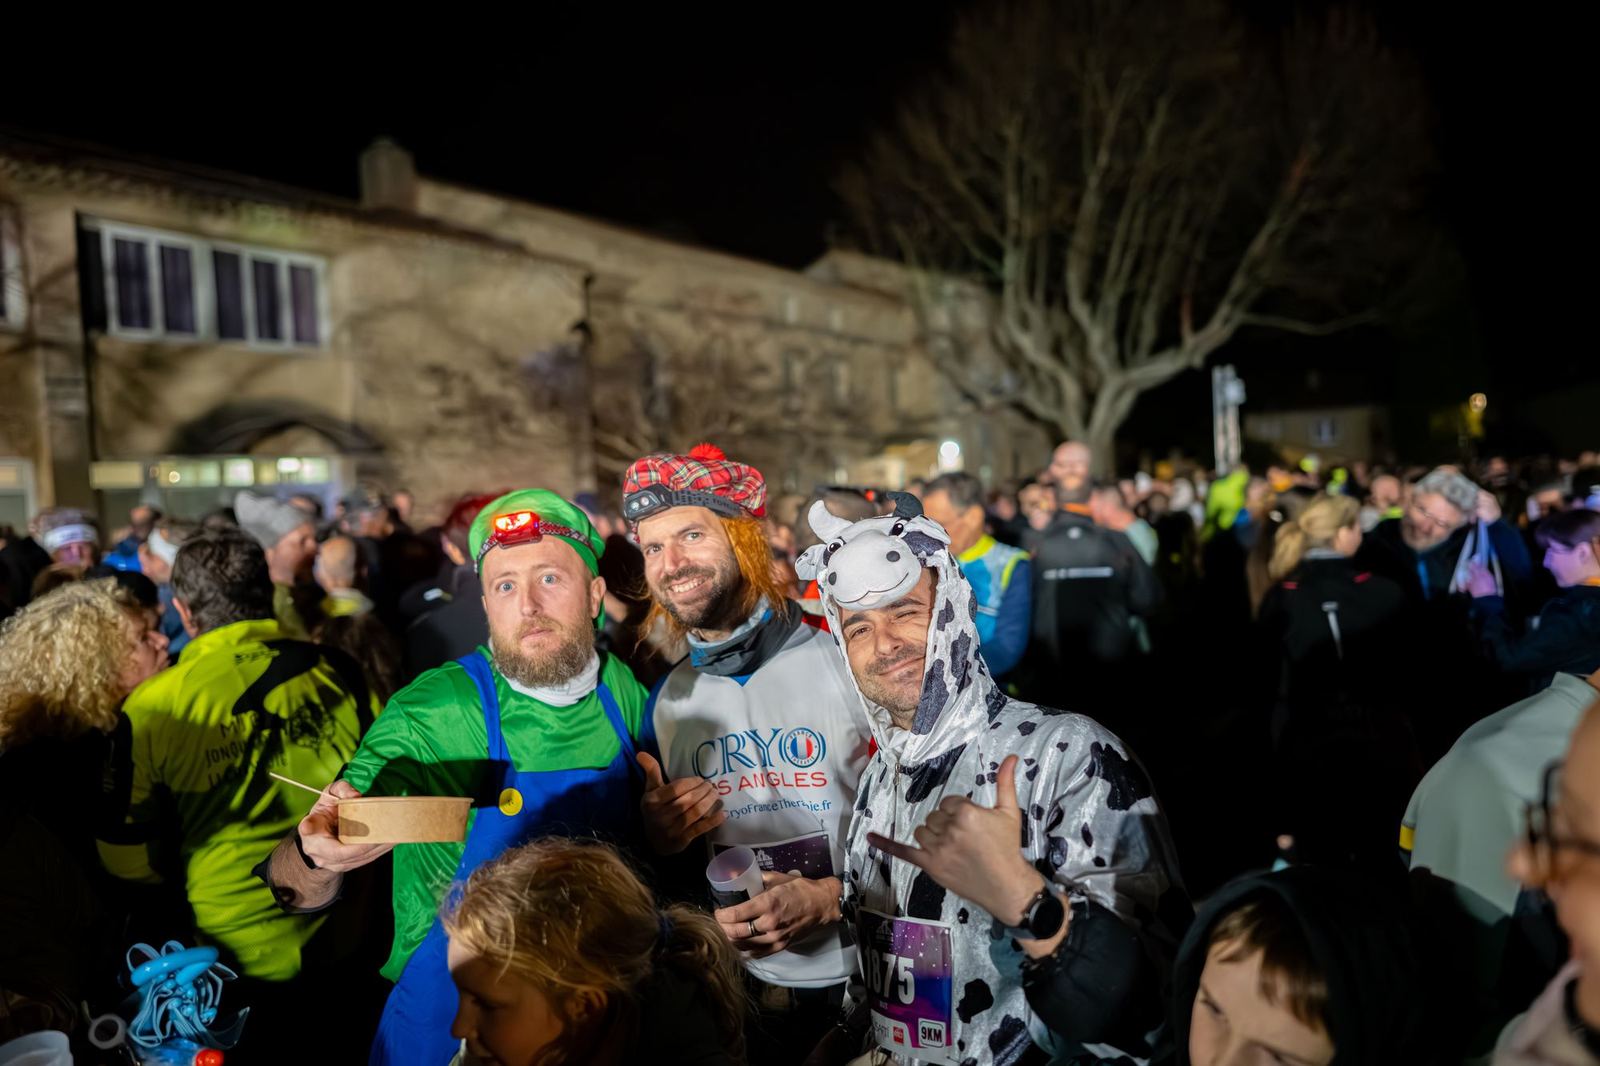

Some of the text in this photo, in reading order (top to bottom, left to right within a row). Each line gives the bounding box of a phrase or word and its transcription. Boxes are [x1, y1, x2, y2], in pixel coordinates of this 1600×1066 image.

[692, 727, 827, 779] CRYO
[738, 771, 828, 792] ANGLES
[723, 798, 832, 820] ryoFranceTheraie.fr
[920, 1026, 943, 1043] 9KM
